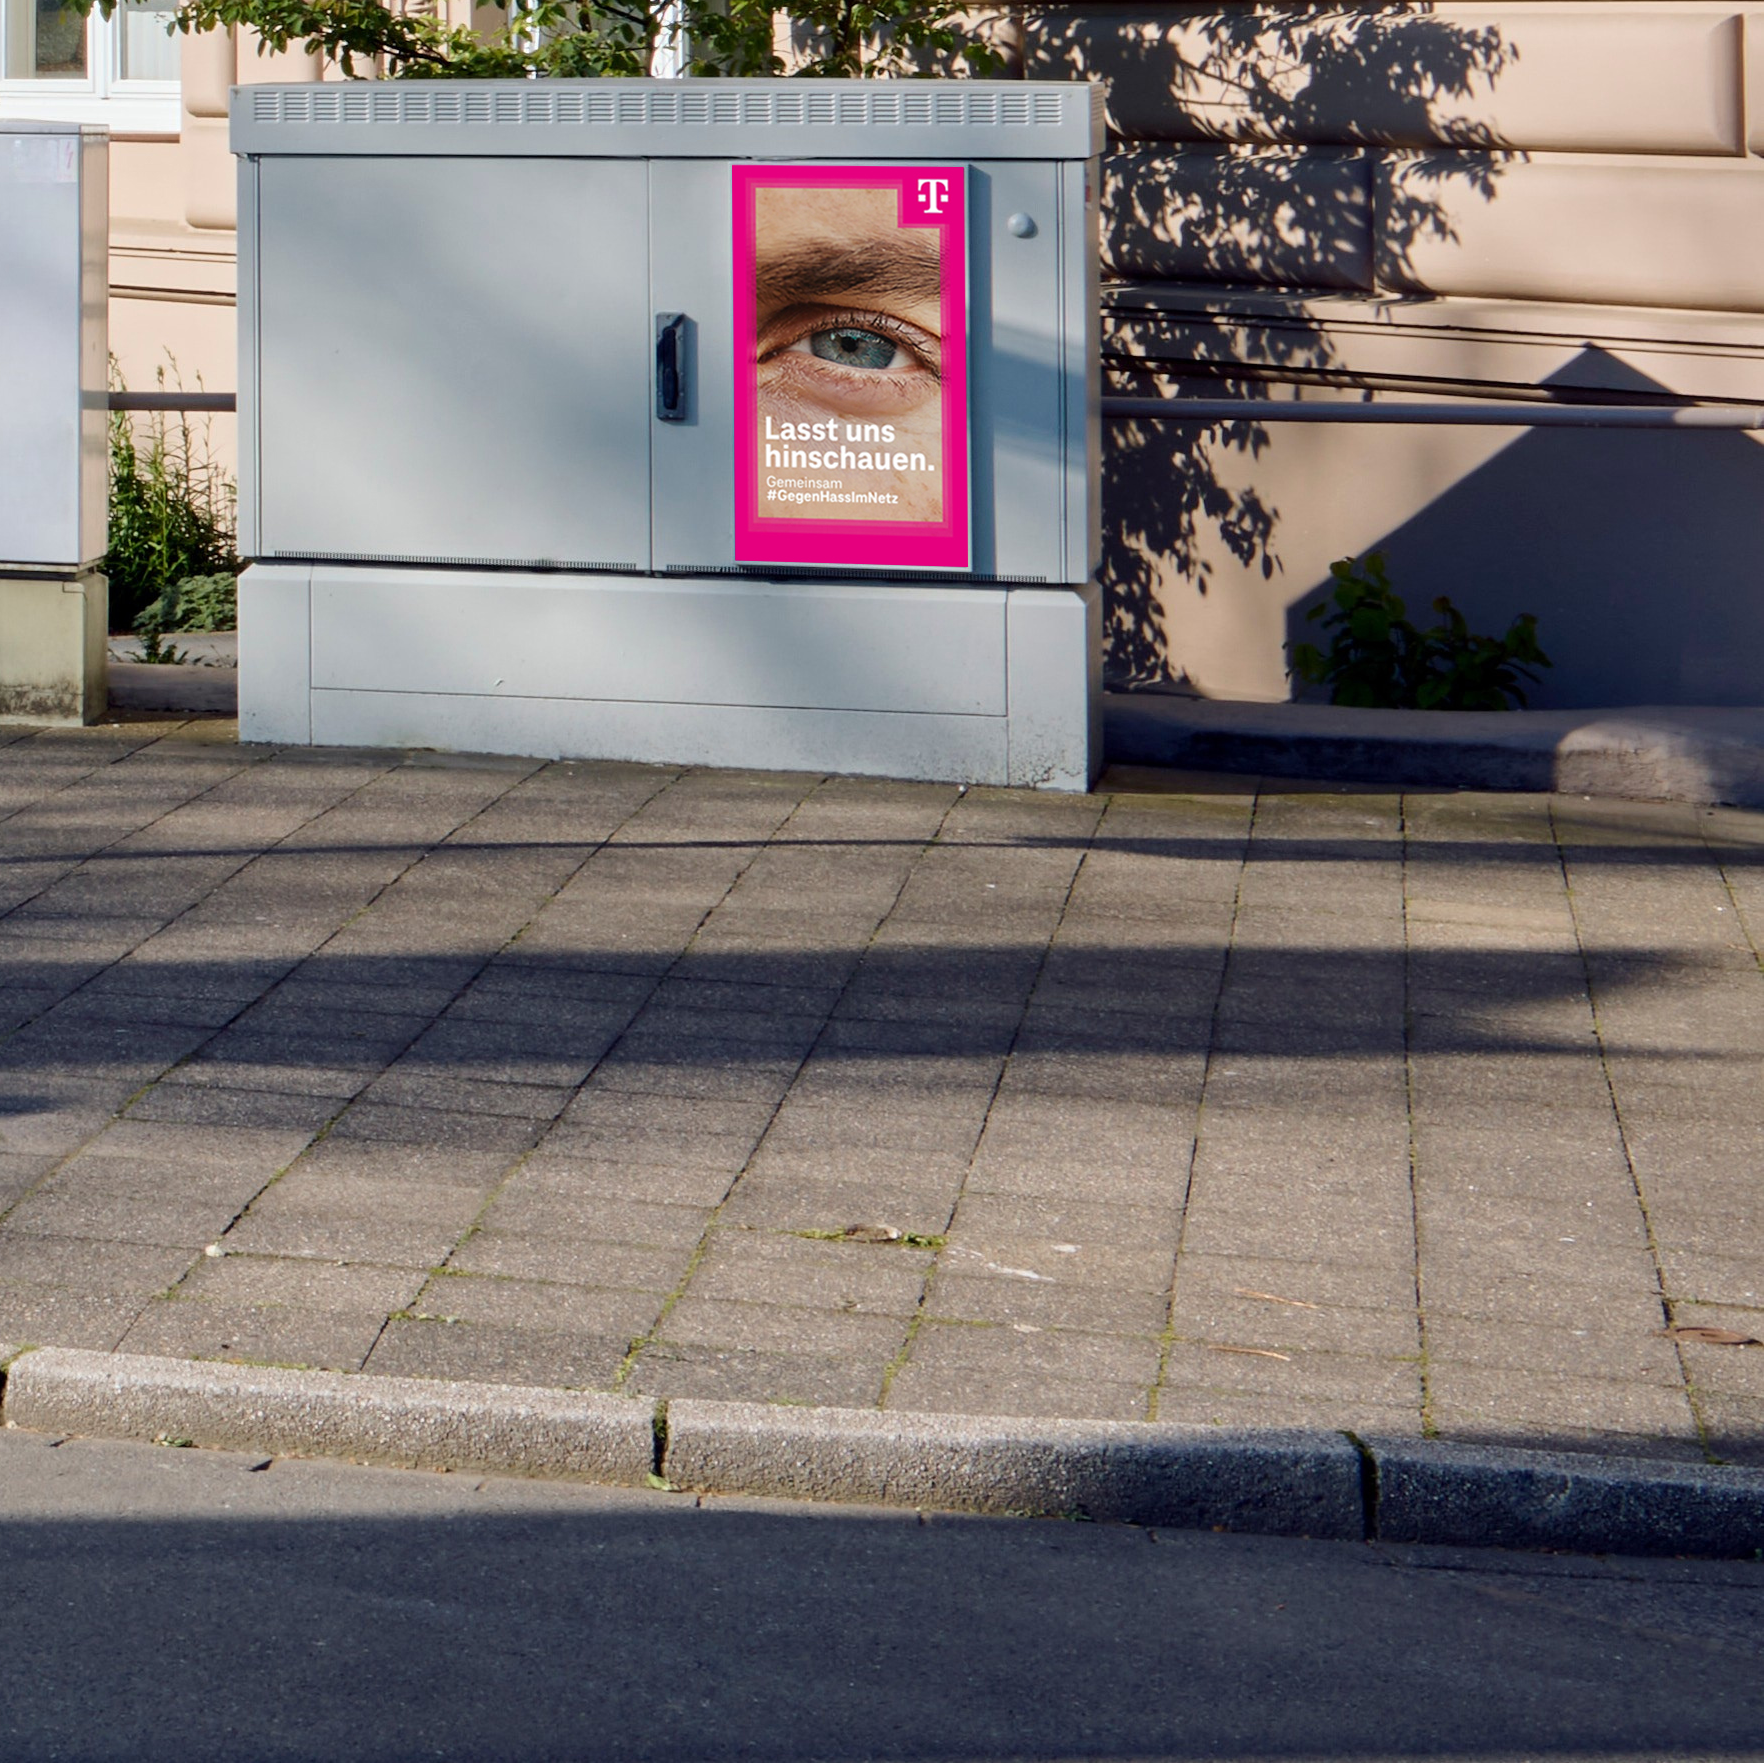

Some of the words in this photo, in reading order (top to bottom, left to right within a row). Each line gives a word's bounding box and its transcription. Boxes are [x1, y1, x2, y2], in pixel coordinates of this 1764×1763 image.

[917, 178, 950, 214] T
[765, 416, 839, 442] Lasst
[846, 423, 896, 443] uns
[765, 444, 935, 472] hinschauen.
[766, 475, 843, 490] Gemeinsam
[766, 489, 899, 505] #GegenHassImNetz
